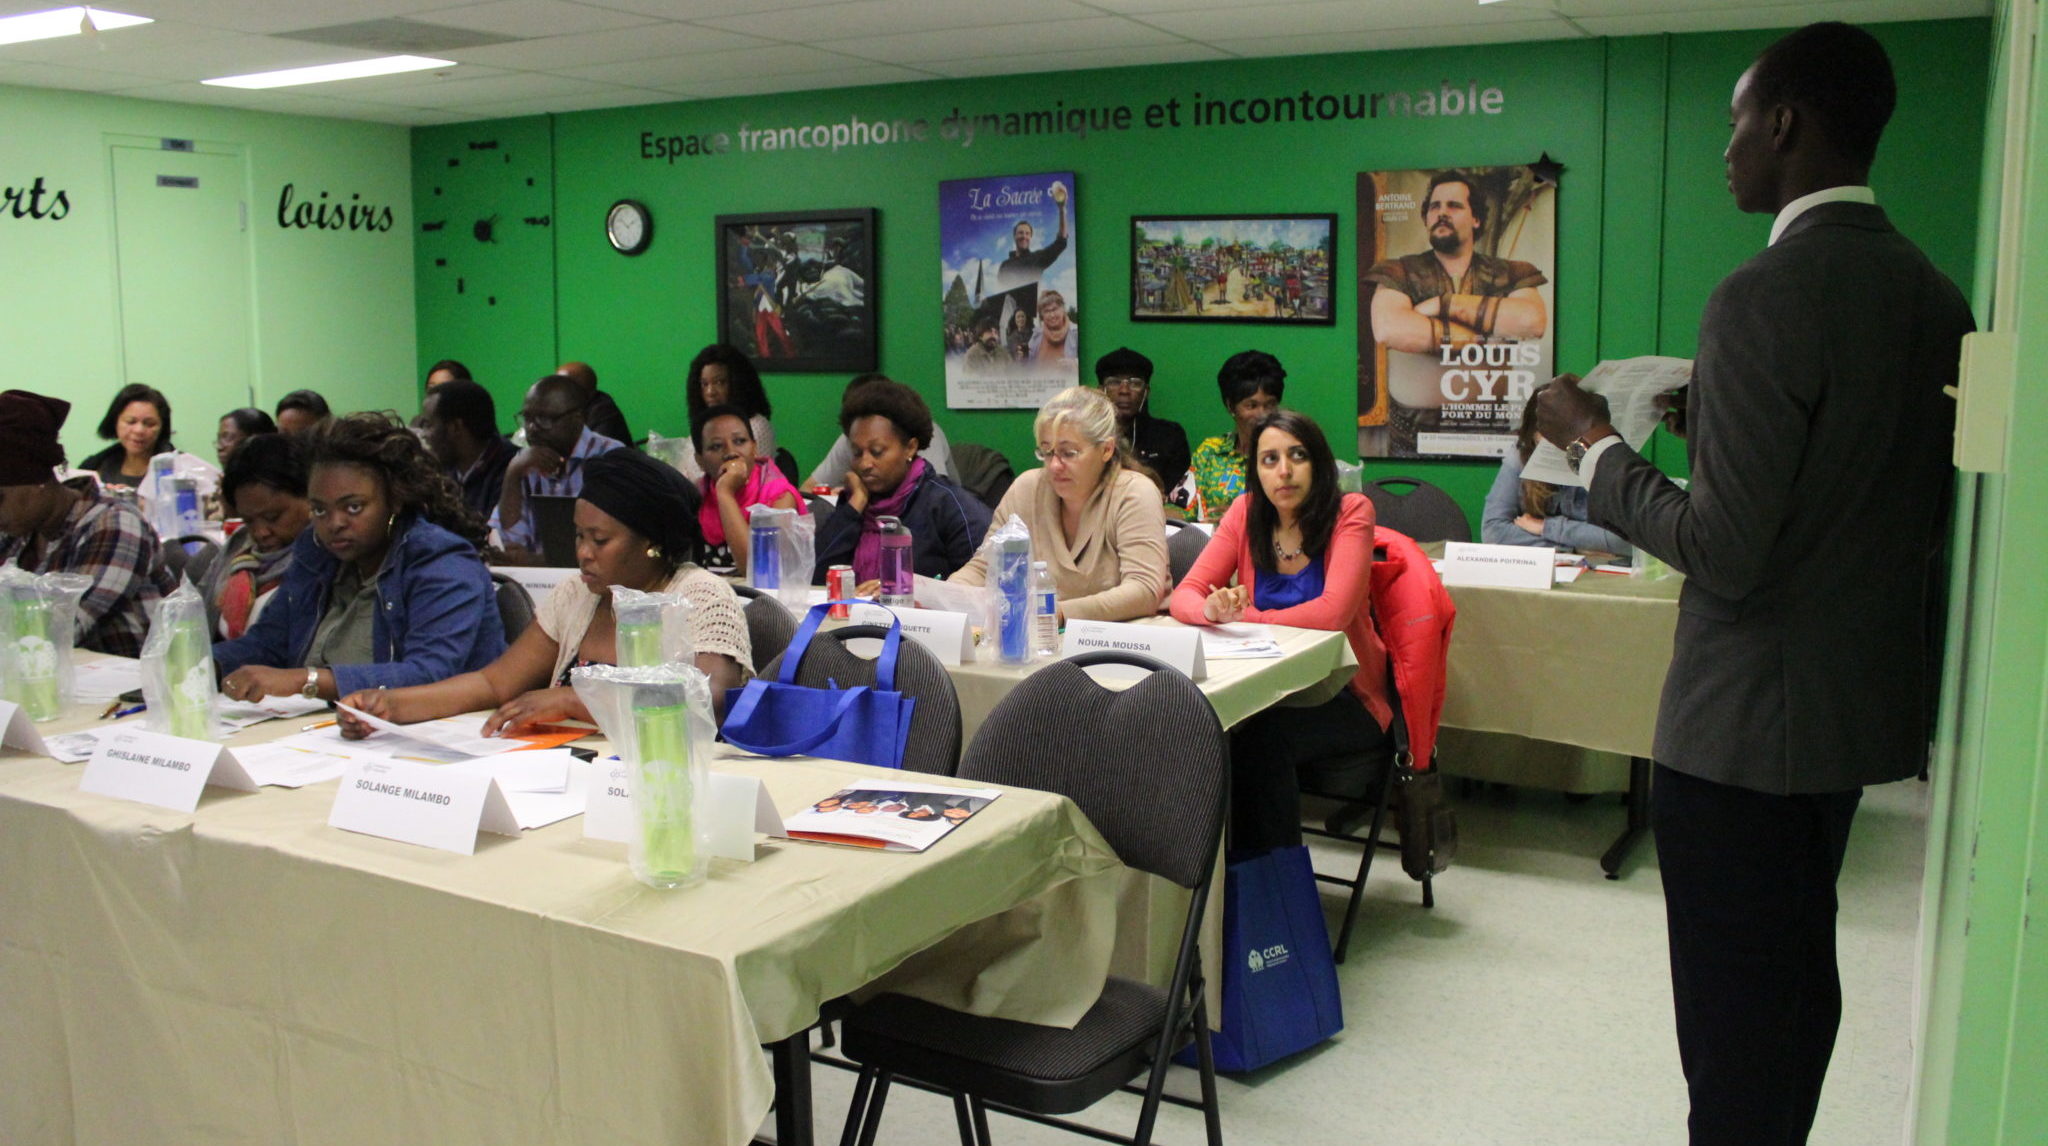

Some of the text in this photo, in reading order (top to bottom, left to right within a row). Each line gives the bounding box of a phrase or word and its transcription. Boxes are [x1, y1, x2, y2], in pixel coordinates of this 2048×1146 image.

[641, 79, 1505, 163] Espace francophone dynamique et incontournable
[0, 177, 70, 220] rts
[968, 188, 991, 210] La
[1375, 201, 1416, 210] BERTRAND
[1379, 193, 1412, 202] ANTOINE
[278, 183, 393, 232] loisirs
[1440, 343, 1540, 367] LOUIS
[1440, 369, 1536, 402] CYR
[1441, 403, 1492, 411] L'HOMME
[1441, 411, 1521, 419] FORT DU MON
[1457, 555, 1538, 566] ALEXANDRA POITRINAL
[1078, 638, 1151, 651] NOURA MOUSSA
[106, 748, 191, 772] GHISLAINE MILAMBO
[355, 779, 451, 806] SOLANGE MILAMBO
[607, 786, 628, 798] SOL
[1263, 944, 1288, 959] CCRL
